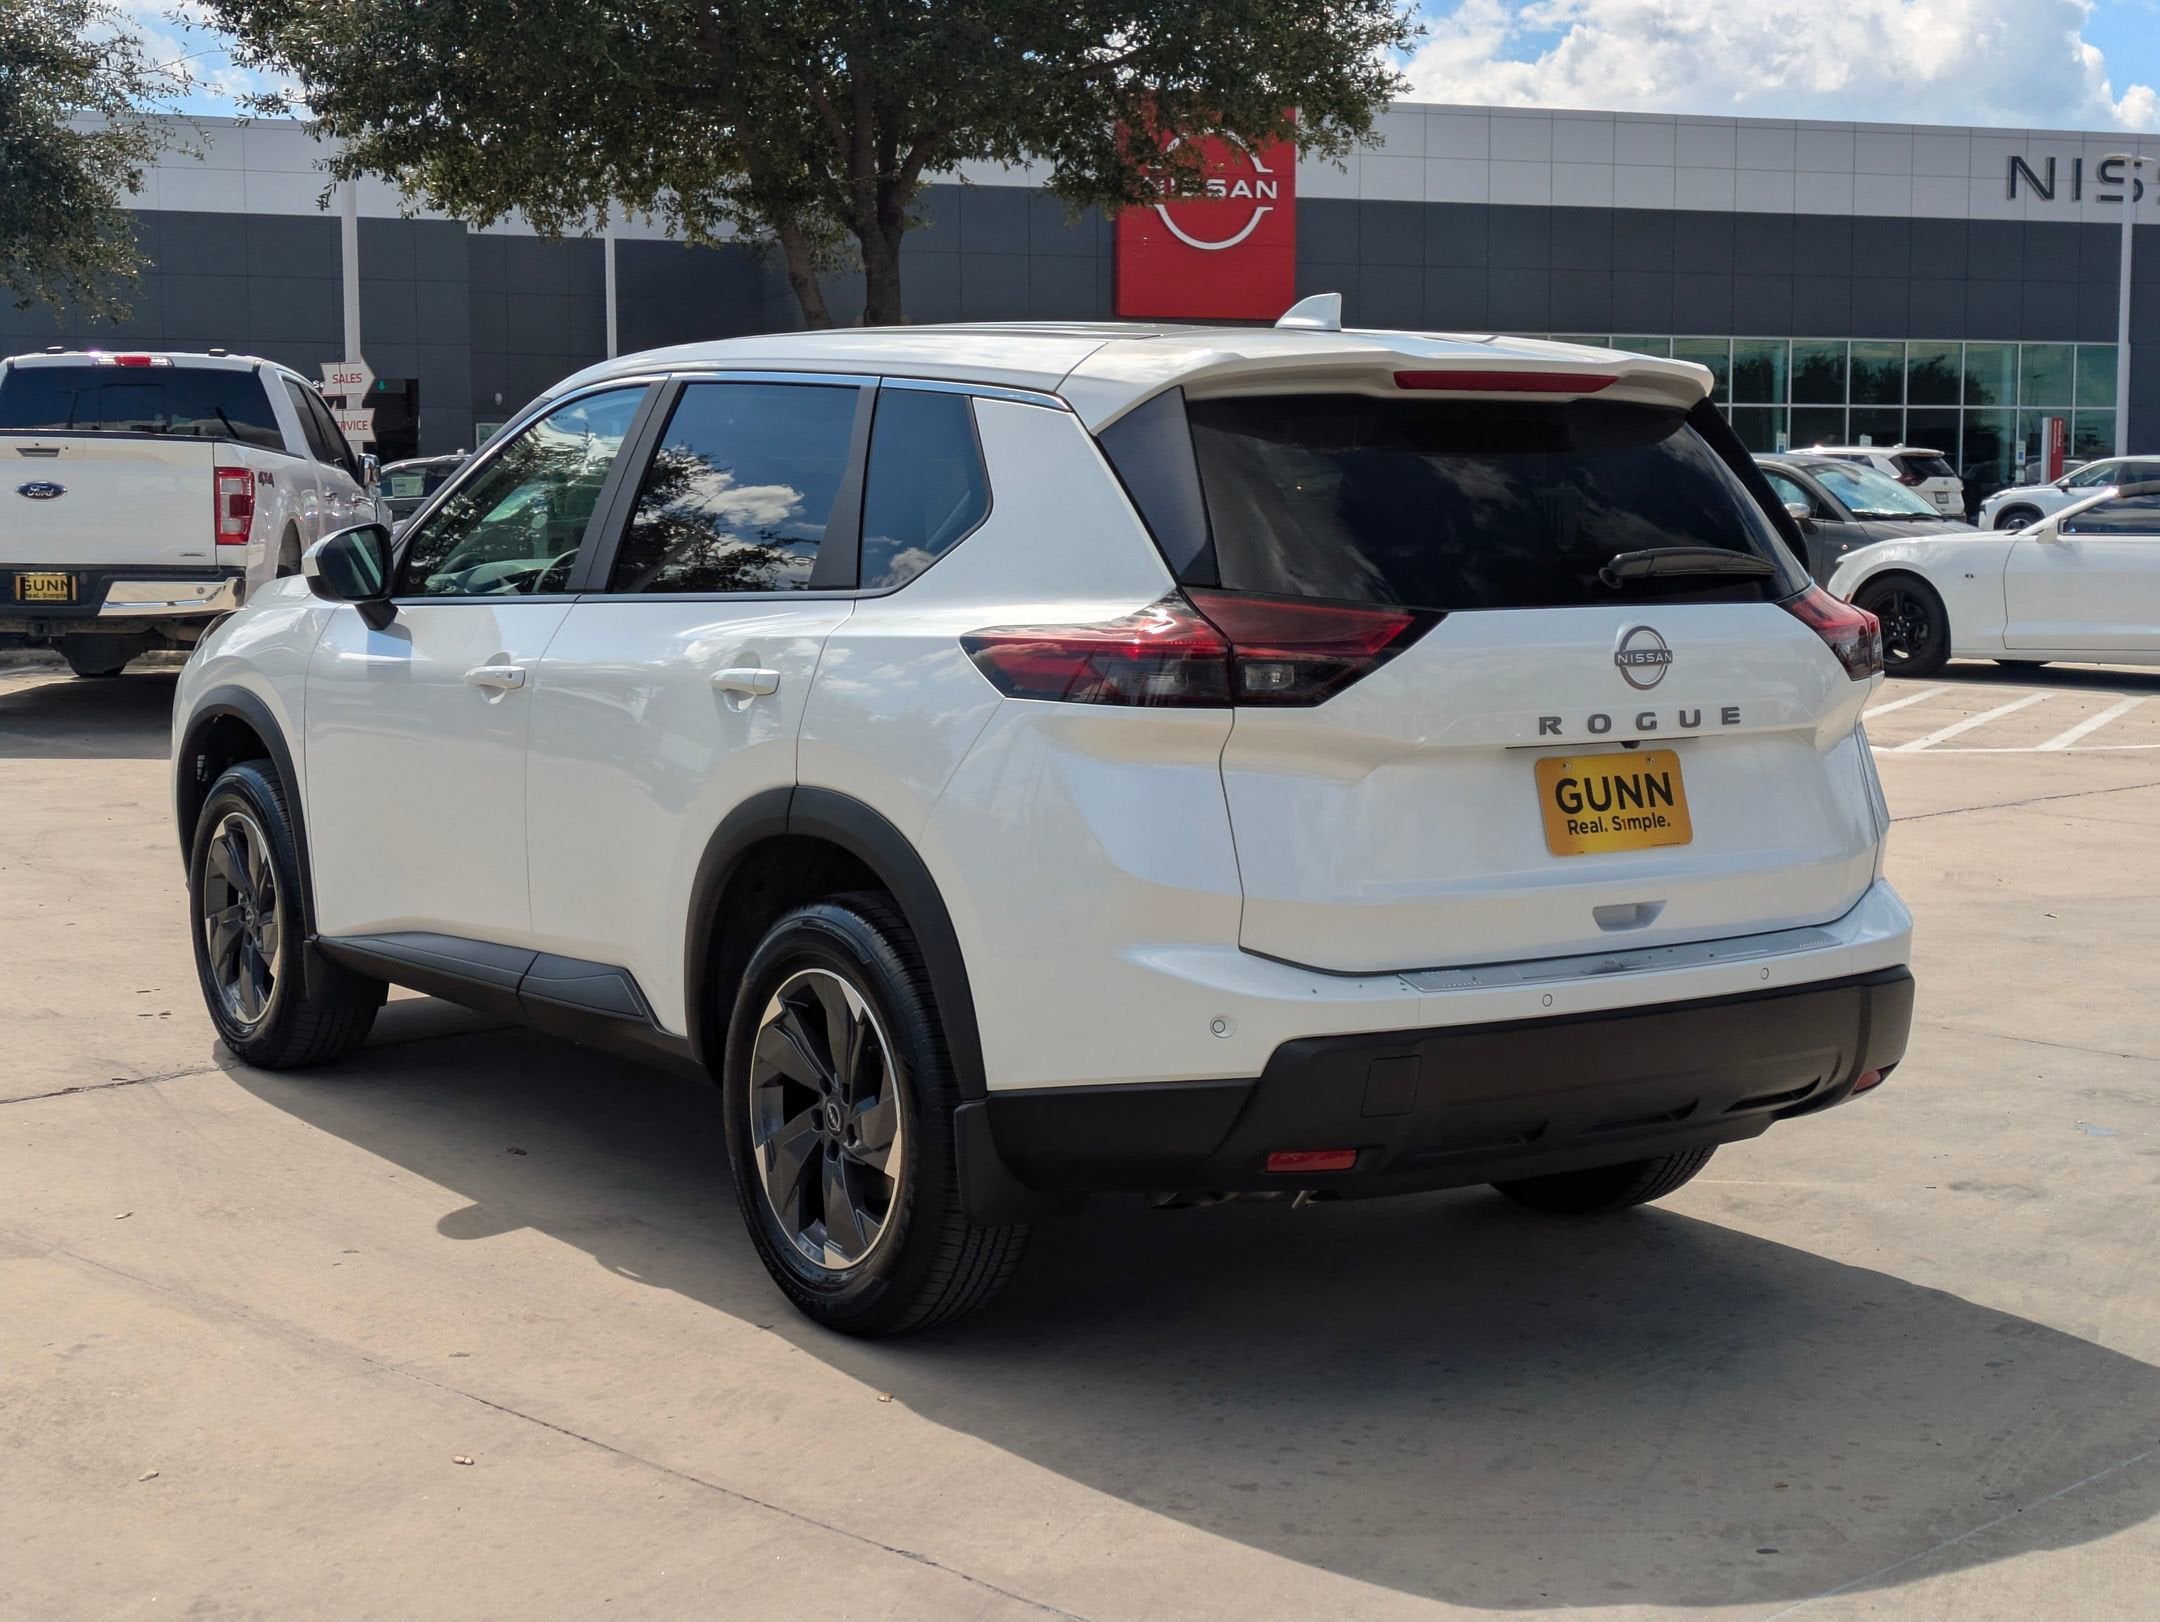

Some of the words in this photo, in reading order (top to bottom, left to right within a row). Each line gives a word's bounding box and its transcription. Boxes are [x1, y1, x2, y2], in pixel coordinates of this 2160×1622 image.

[2007, 155, 2160, 204] NIS
[332, 373, 363, 384] SALES
[336, 420, 368, 431] RVICE
[27, 485, 55, 497] Ford
[25, 579, 68, 592] GUNN
[1617, 652, 1672, 666] NISSAN
[1539, 706, 1741, 736] ROGUE
[1555, 772, 1674, 815] GUNN
[1567, 816, 1608, 836] Real.
